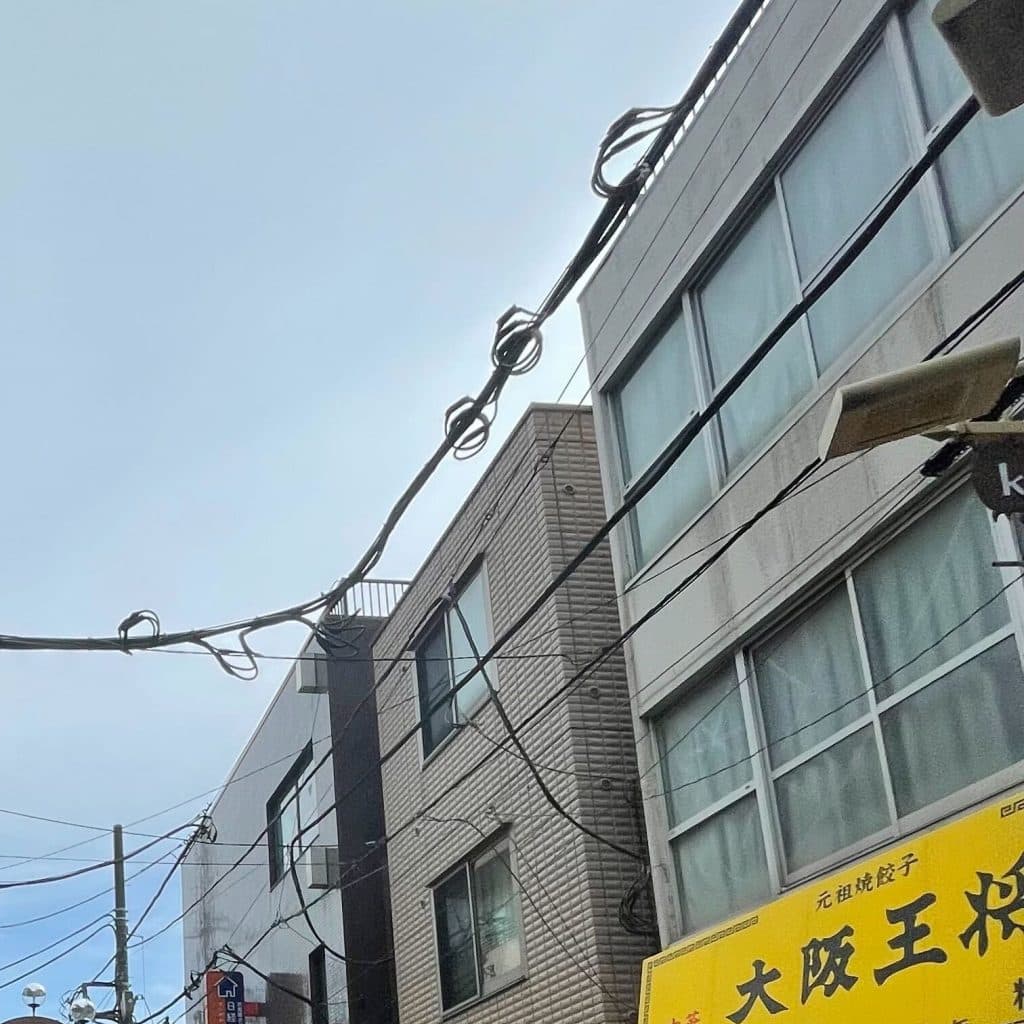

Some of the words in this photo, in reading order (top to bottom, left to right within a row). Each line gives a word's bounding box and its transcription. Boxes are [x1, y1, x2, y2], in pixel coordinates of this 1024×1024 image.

[815, 852, 919, 912] 元祖焼餃子
